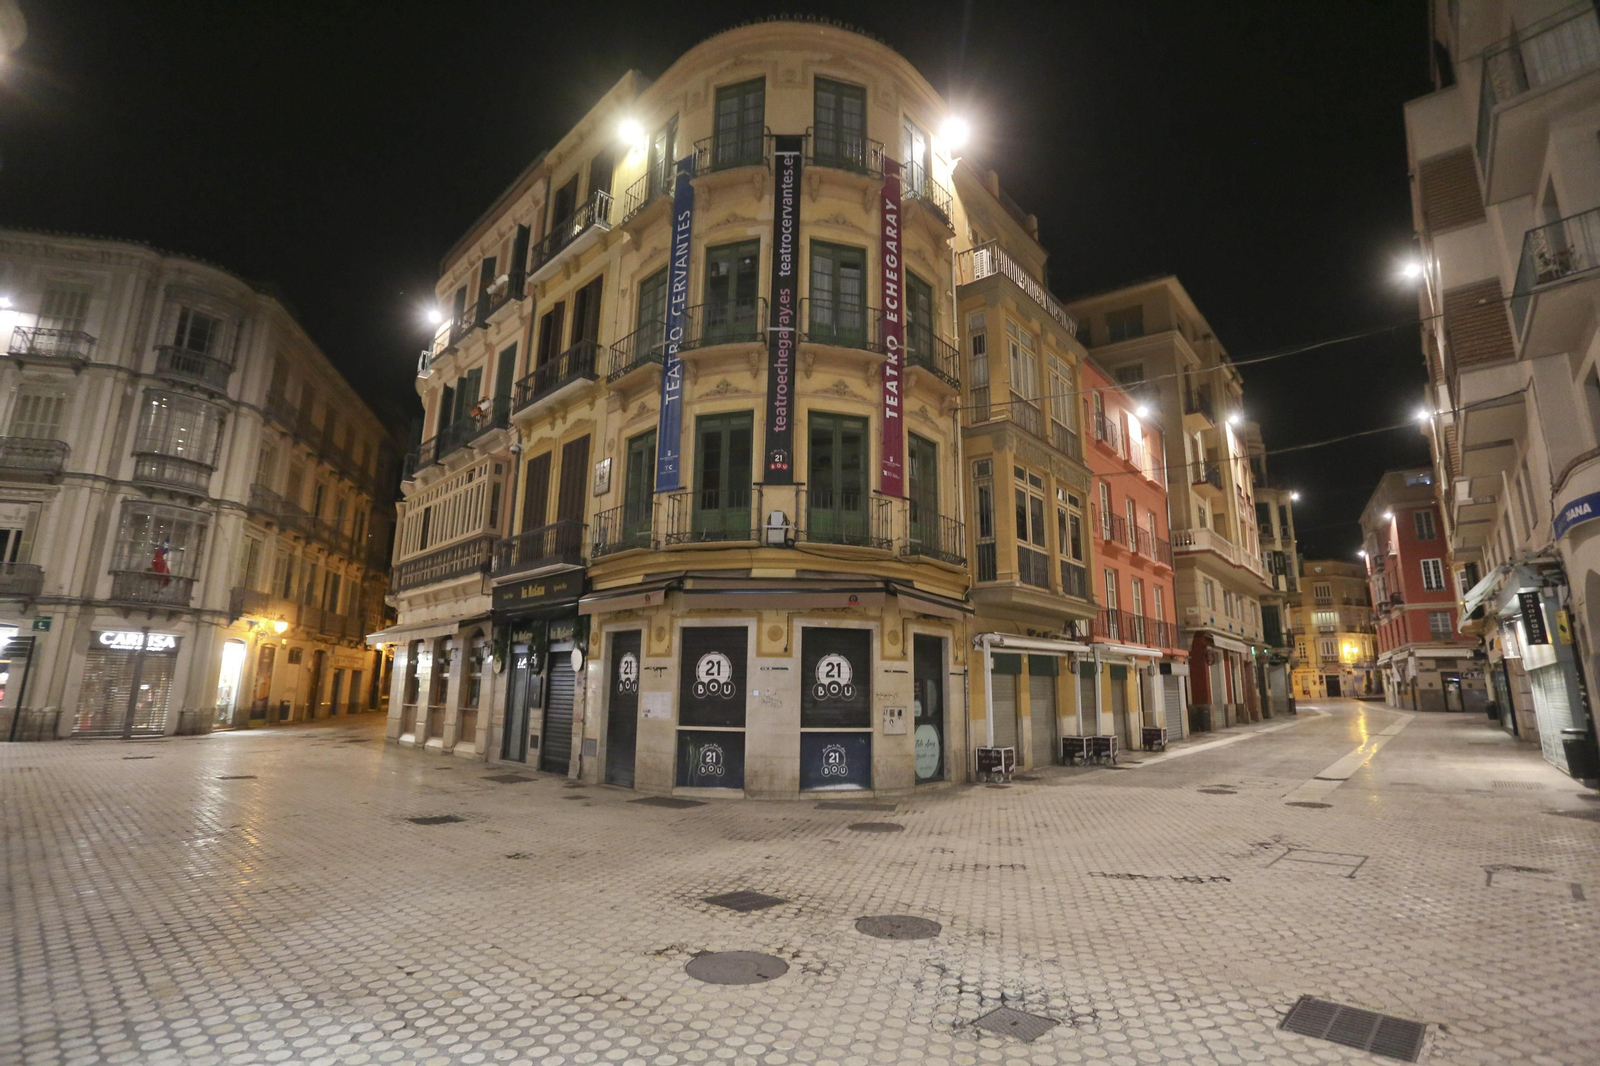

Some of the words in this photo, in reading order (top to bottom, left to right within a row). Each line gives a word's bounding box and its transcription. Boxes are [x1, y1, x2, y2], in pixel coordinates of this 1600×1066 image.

[779, 152, 794, 277] teatrocervantes.es
[671, 210, 691, 316] CERVANTES
[885, 198, 898, 323] ECHEGARAY
[665, 326, 683, 406] TEATRO
[773, 288, 793, 433] teatroechegaray.es
[885, 335, 898, 419] TEATRO
[774, 454, 783, 462] 21
[624, 660, 632, 675] 21
[705, 660, 721, 676] 21
[825, 662, 841, 678] 21
[619, 681, 638, 692] BOU
[697, 682, 731, 695] BOU
[817, 685, 852, 696] BOU
[705, 751, 716, 763] 21
[829, 752, 839, 763] 21
[701, 765, 722, 774] BOU
[824, 766, 846, 774] BOU
